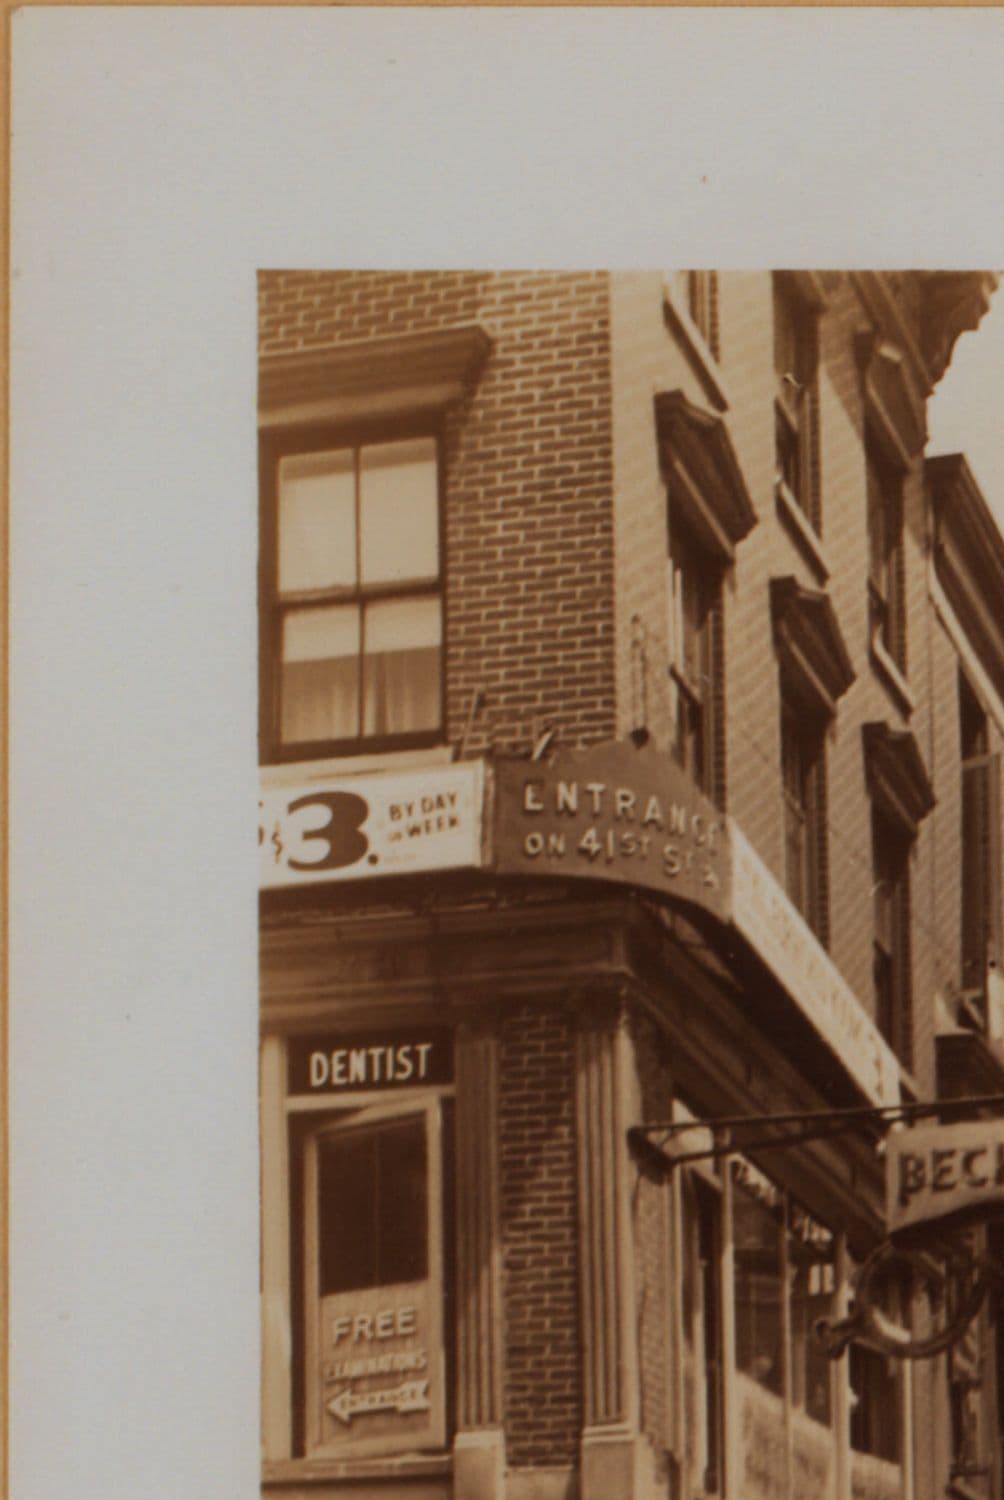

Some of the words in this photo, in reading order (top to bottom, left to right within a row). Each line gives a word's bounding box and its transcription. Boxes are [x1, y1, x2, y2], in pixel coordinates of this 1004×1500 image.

[389, 802, 415, 821] BY
[421, 792, 457, 813] DAY
[524, 781, 721, 847] ENTRANCE
[525, 831, 566, 855] ON
[310, 1043, 432, 1087] DENTIST
[333, 1306, 417, 1344] FREE
